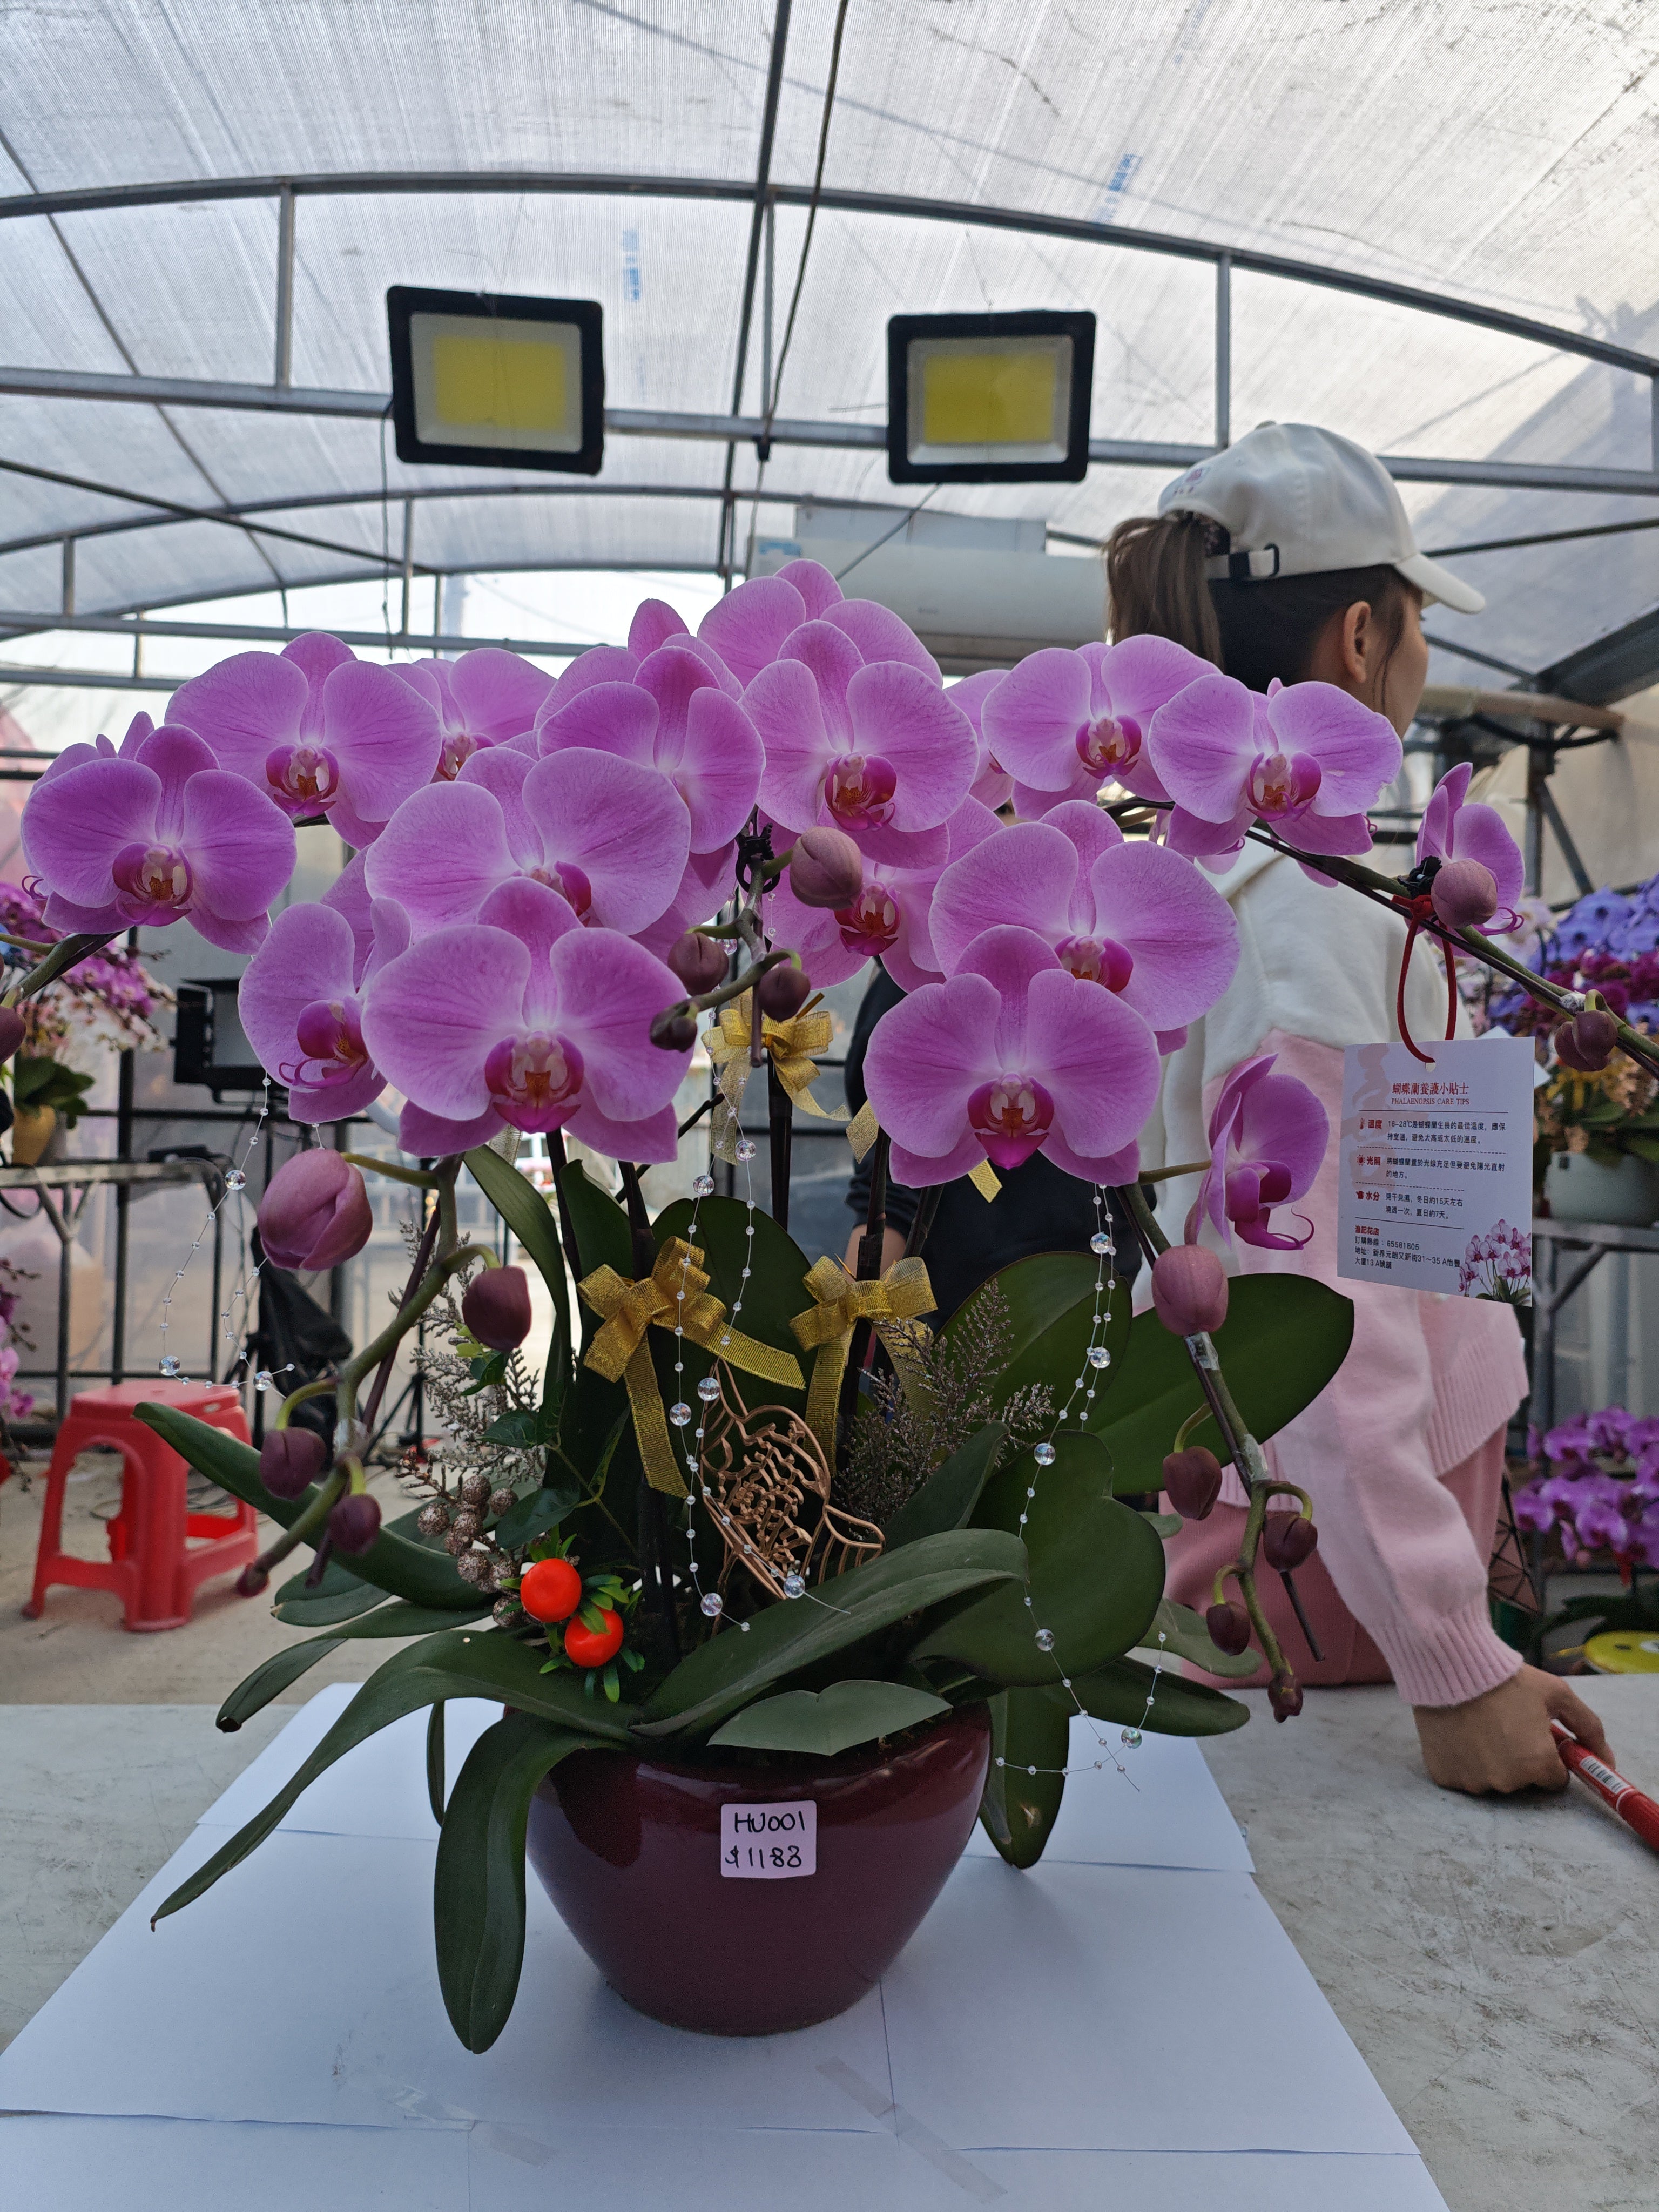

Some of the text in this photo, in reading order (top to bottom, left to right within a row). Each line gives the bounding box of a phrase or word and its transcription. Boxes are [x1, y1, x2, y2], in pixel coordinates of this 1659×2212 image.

[1392, 1082, 1469, 1095] 蝴蝶蘭養護小貼士
[1366, 1155, 1381, 1166] 光照
[1386, 1170, 1408, 1179] 的地方。
[1365, 1190, 1380, 1201] 水分
[734, 1810, 805, 1833] HU001
[724, 1845, 802, 1869] $1188
